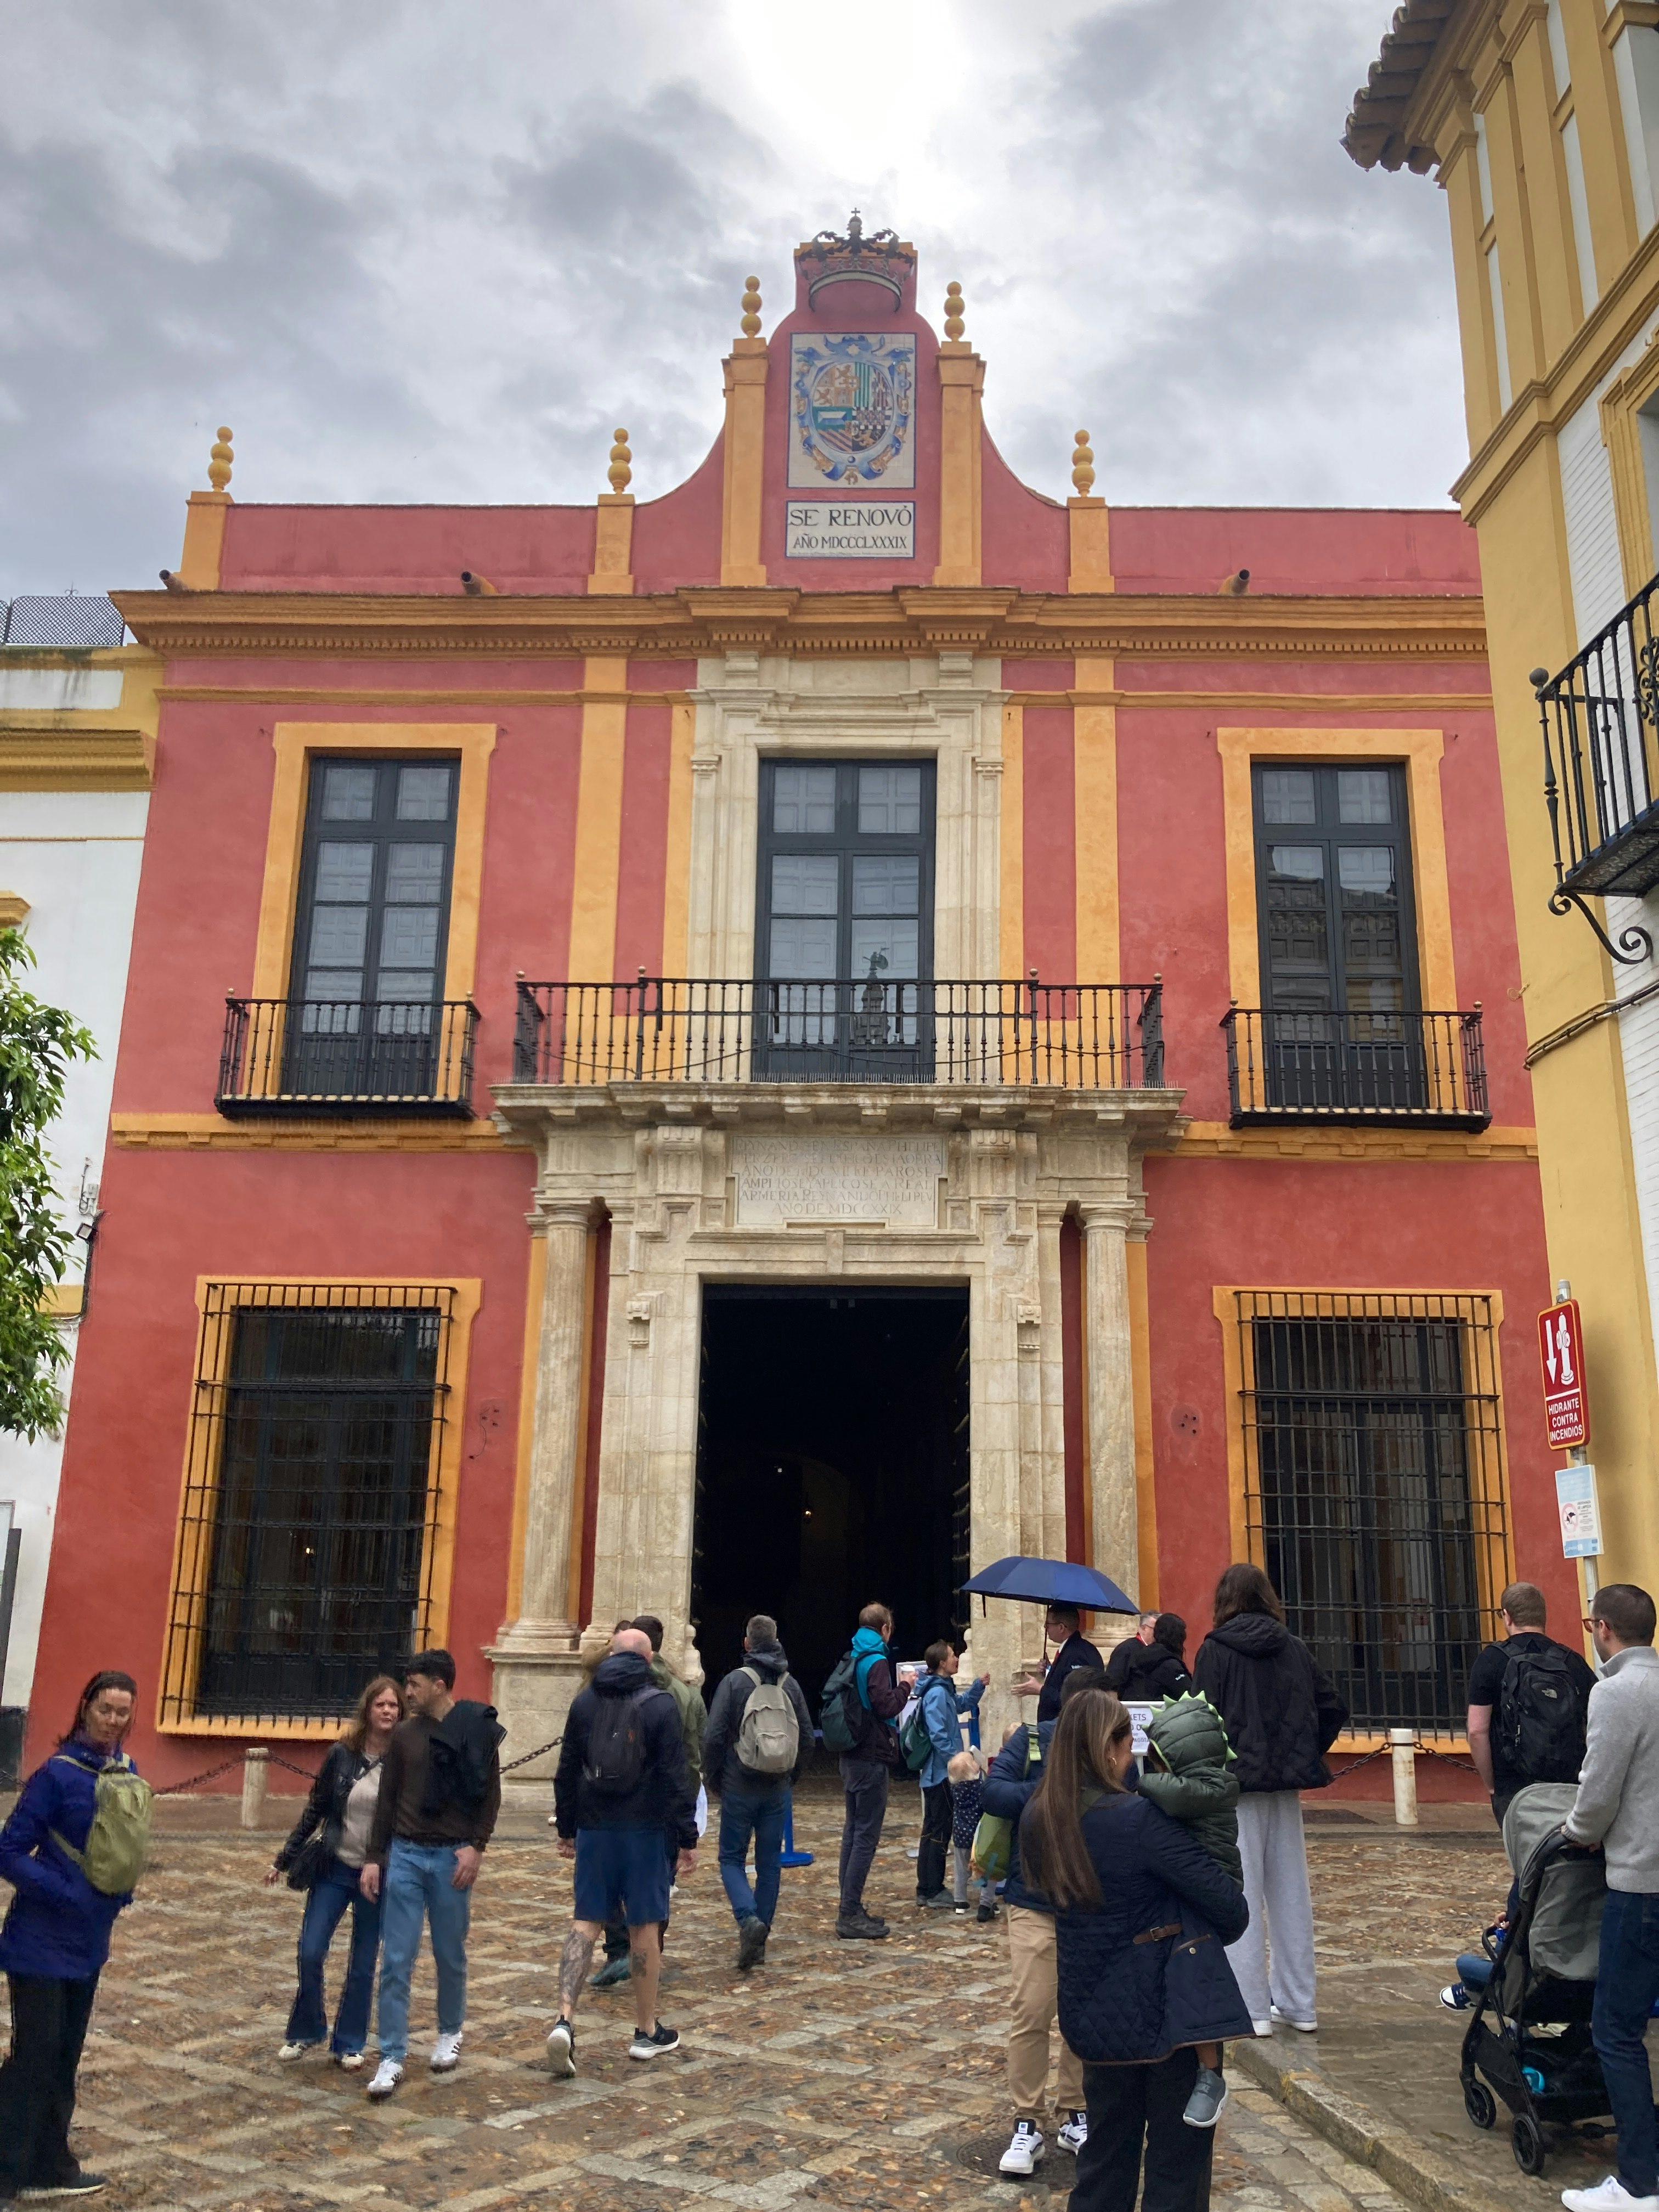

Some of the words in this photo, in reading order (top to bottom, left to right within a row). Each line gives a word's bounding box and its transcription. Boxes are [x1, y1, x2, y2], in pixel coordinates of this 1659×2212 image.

[788, 509, 820, 526] SE
[792, 533, 819, 549] AÑO
[821, 535, 907, 549] MDCCCLXXXIX
[1548, 1397, 1579, 1415] HIDRANTE
[1552, 1412, 1579, 1428] CONTRA
[1550, 1424, 1583, 1442] INCENDIOS
